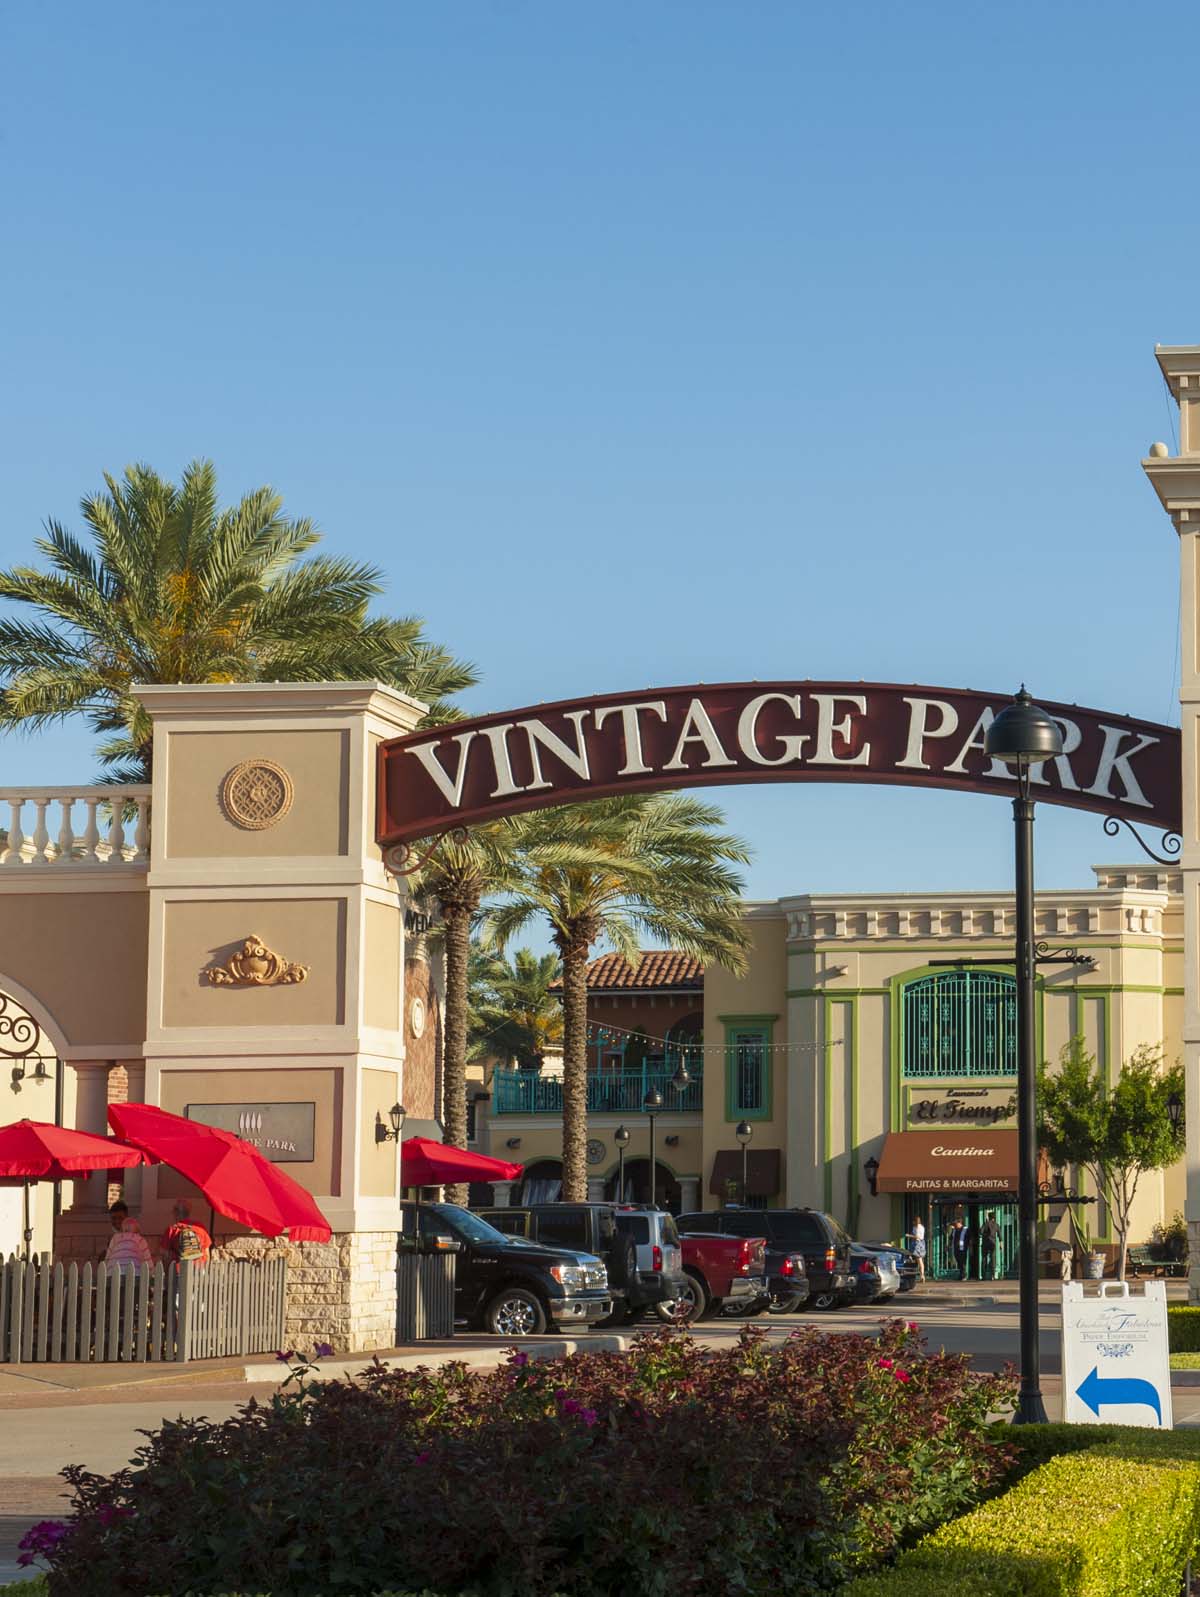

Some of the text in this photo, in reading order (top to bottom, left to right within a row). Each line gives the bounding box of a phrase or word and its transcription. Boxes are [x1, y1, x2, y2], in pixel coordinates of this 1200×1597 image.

[404, 692, 871, 808] VINTAGE
[917, 1100, 1016, 1123] El Tiempo
[266, 1139, 297, 1152] PARK
[930, 1146, 995, 1157] Cantina
[906, 1180, 1009, 1189] FAJITAS & MARGARITAS
